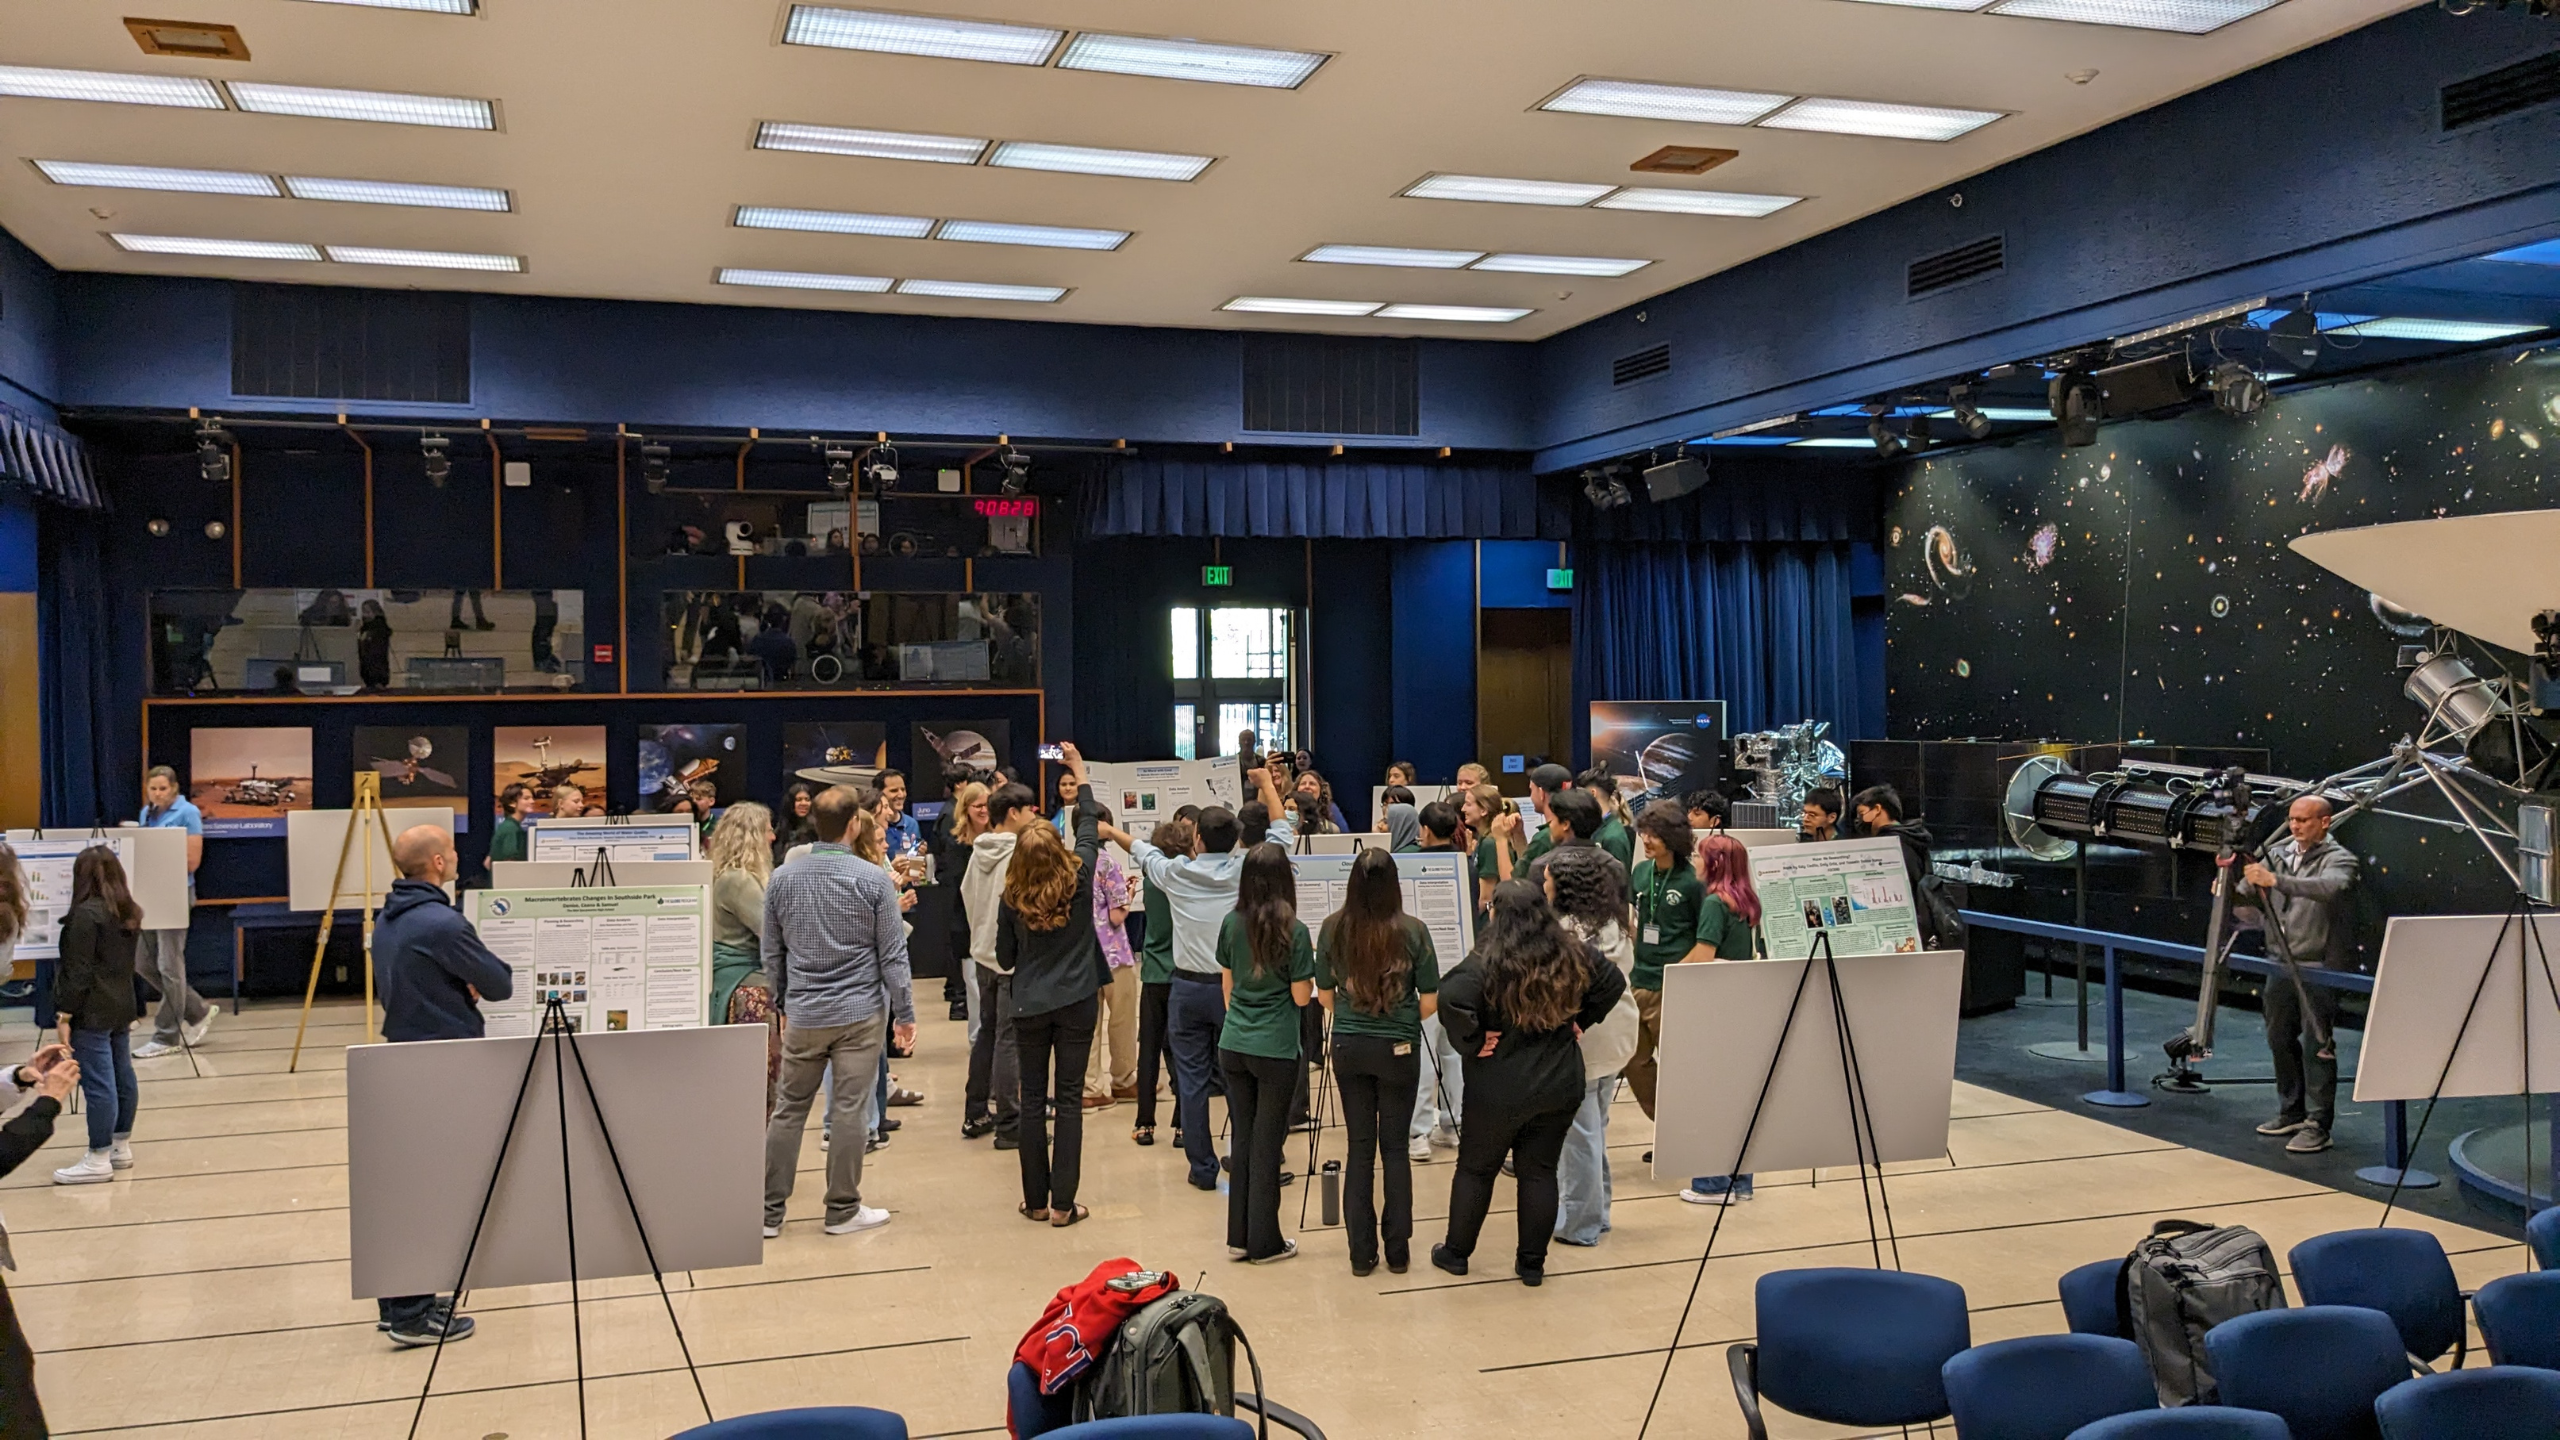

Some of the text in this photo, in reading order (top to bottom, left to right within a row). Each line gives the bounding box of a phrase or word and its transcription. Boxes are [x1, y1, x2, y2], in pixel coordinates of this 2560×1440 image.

[1207, 566, 1229, 585] EXIT
[1553, 569, 1573, 588] EXIT
[214, 822, 239, 830] Science
[240, 821, 273, 830] Laboratory
[524, 895, 582, 903] Macroinvertebrates
[614, 893, 642, 901] Southside
